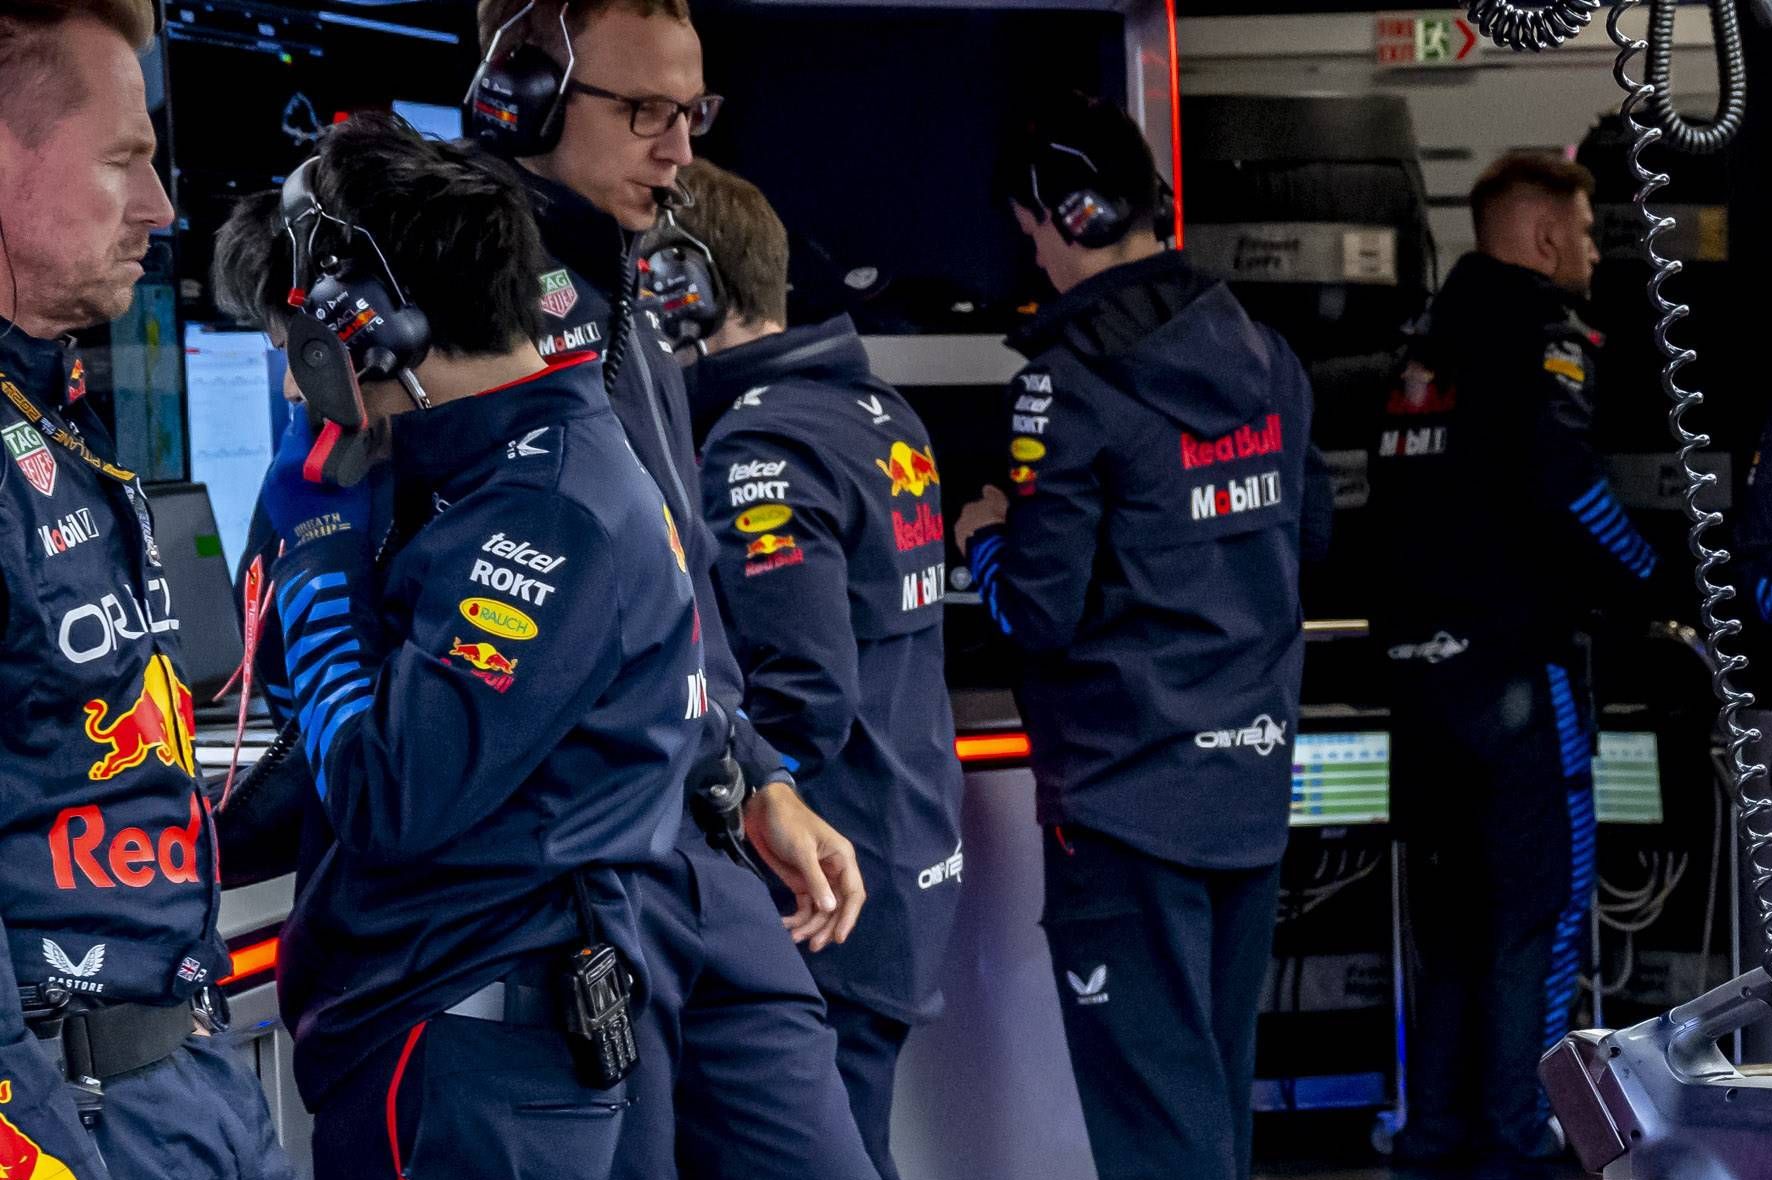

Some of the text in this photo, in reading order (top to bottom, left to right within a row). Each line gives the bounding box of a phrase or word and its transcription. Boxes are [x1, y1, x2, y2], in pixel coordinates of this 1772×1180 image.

[542, 273, 569, 292] AG
[538, 326, 585, 356] Mobil
[6, 426, 40, 456] TAG
[1180, 413, 1282, 470] Red Bull
[23, 453, 54, 491] HEUER
[728, 460, 787, 483] telcel
[731, 481, 789, 507] ROKT
[1191, 475, 1260, 521] Mobil
[38, 512, 88, 557] Mobil
[482, 532, 566, 574] telcel
[469, 558, 556, 607] ROKT
[479, 607, 529, 634] RAUCH
[48, 791, 202, 890] Red
